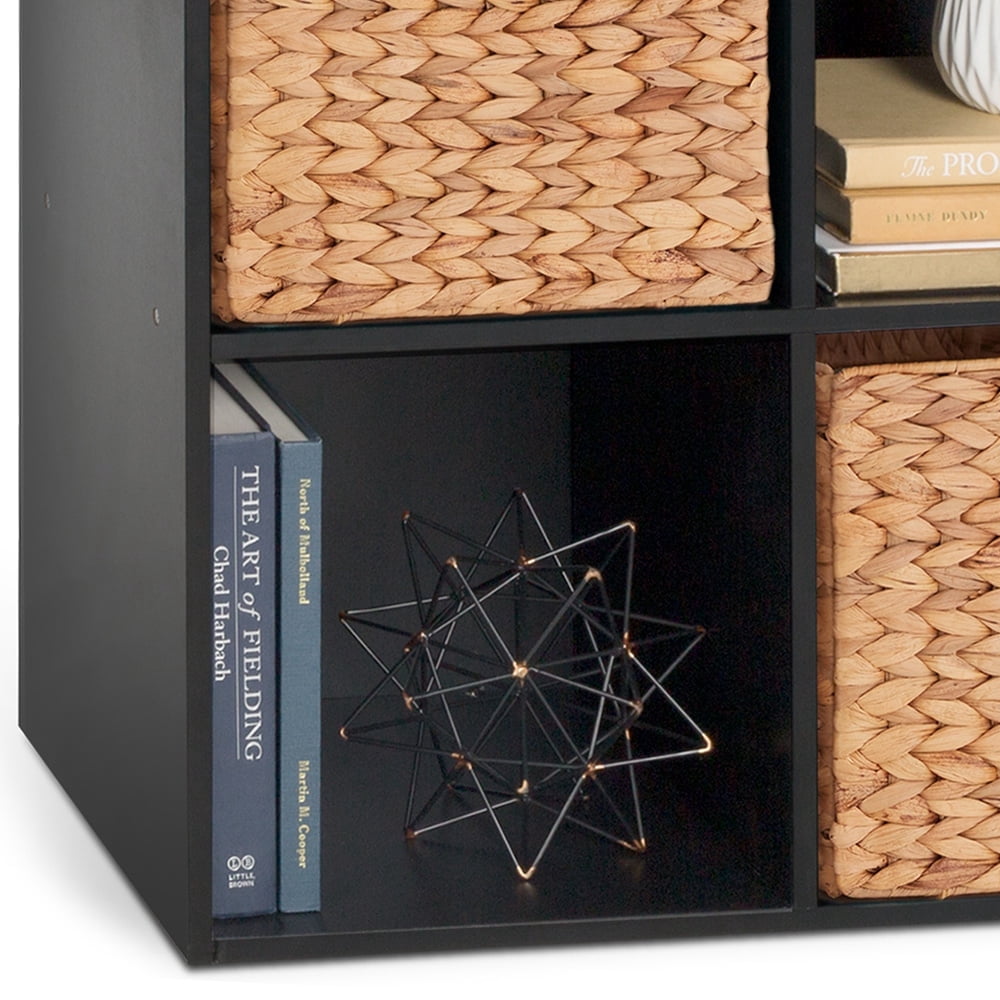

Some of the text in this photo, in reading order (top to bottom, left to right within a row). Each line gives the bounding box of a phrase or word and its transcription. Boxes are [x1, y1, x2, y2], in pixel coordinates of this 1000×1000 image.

[901, 155, 935, 177] The
[299, 478, 311, 604] North of Mulholland
[213, 545, 231, 681] Chad Harbach
[237, 465, 263, 761] THE ART of FIELDING
[296, 760, 310, 869] Martin M. Cooper
